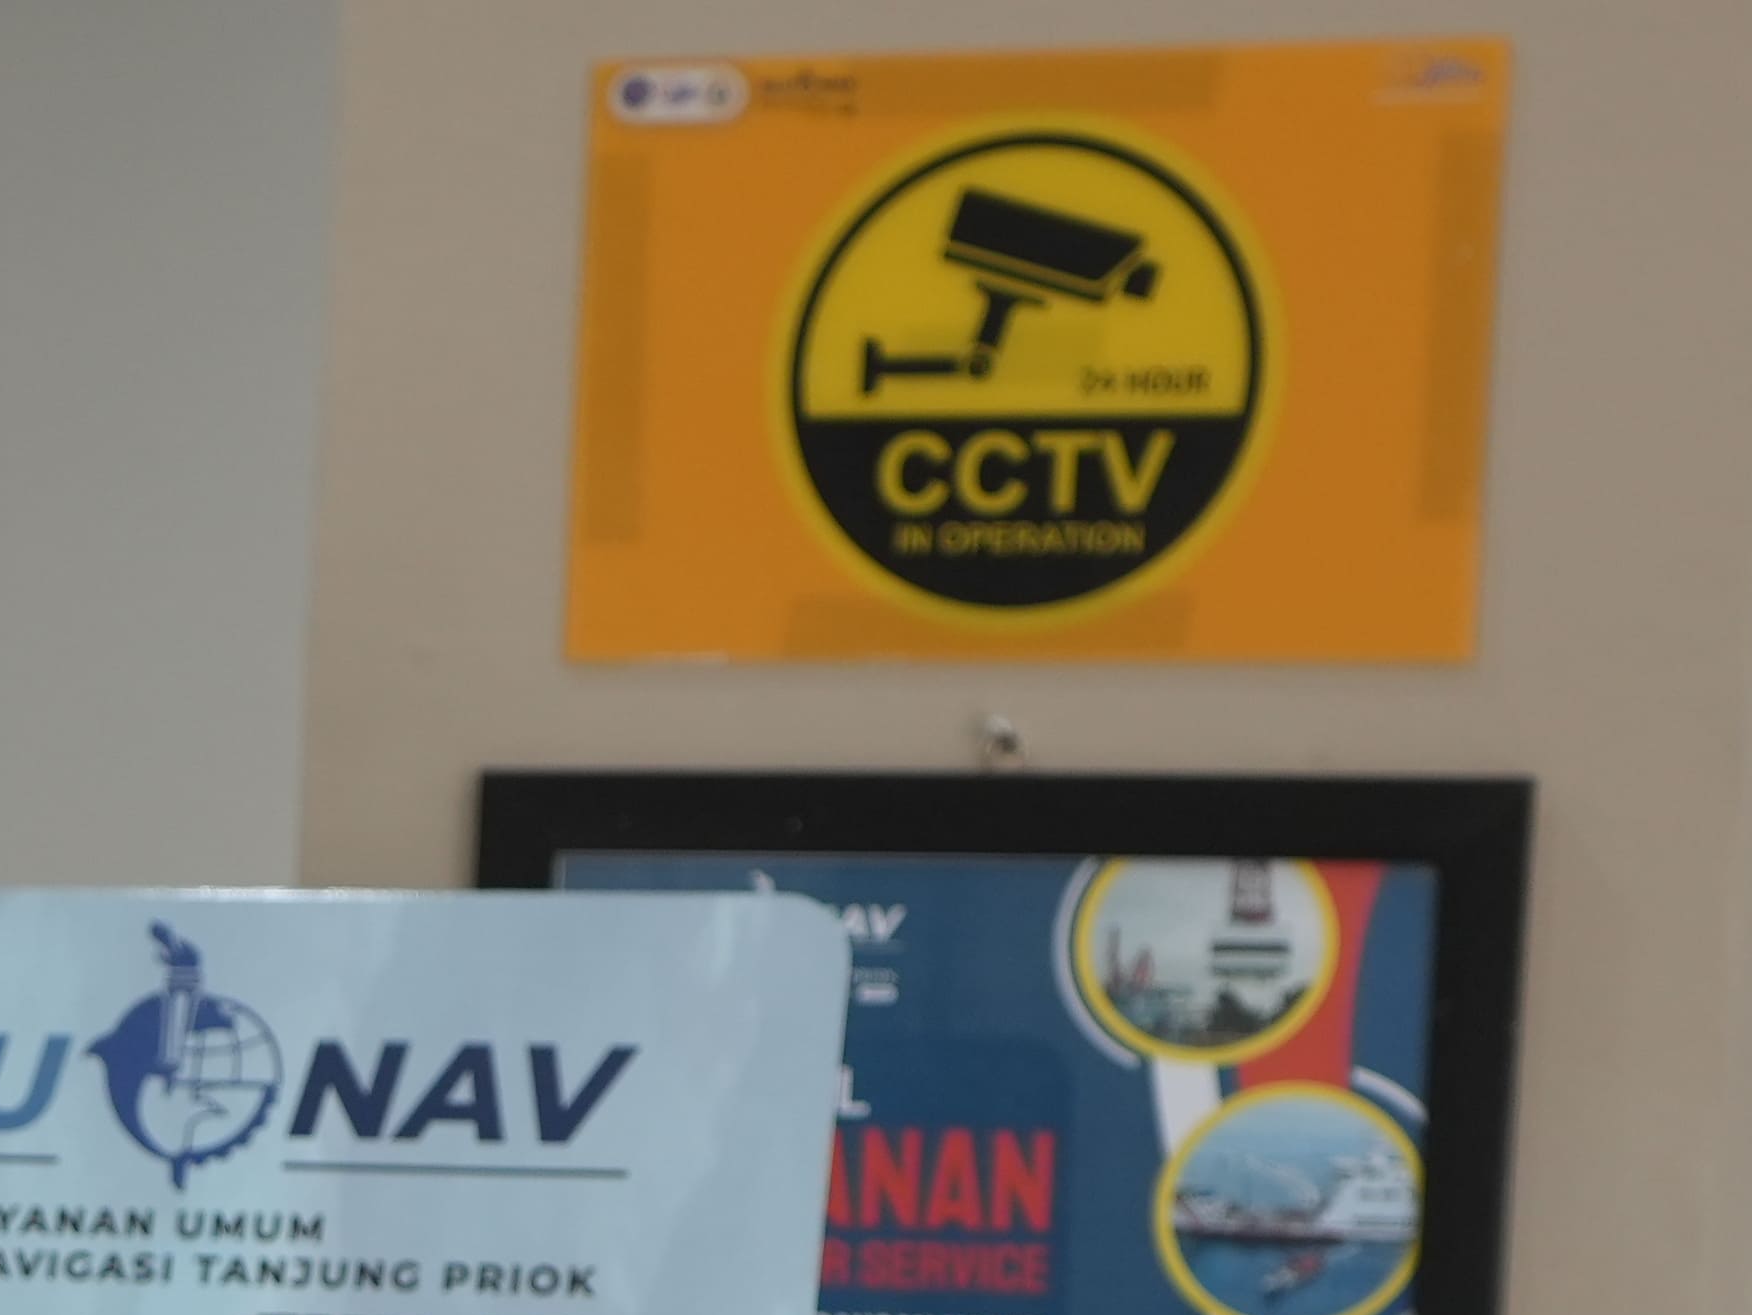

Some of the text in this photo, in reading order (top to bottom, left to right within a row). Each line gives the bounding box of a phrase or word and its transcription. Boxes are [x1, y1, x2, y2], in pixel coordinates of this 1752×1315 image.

[1127, 368, 1211, 395] HOUR
[876, 429, 1177, 516] CCTV
[894, 521, 1146, 556] IN OPERATION
[287, 1040, 641, 1145] NAV
[177, 1210, 325, 1244] UMUM
[196, 1255, 420, 1295] TANJUNG
[441, 1263, 597, 1299] PRIOK
[859, 1239, 1050, 1296] SERVICE
